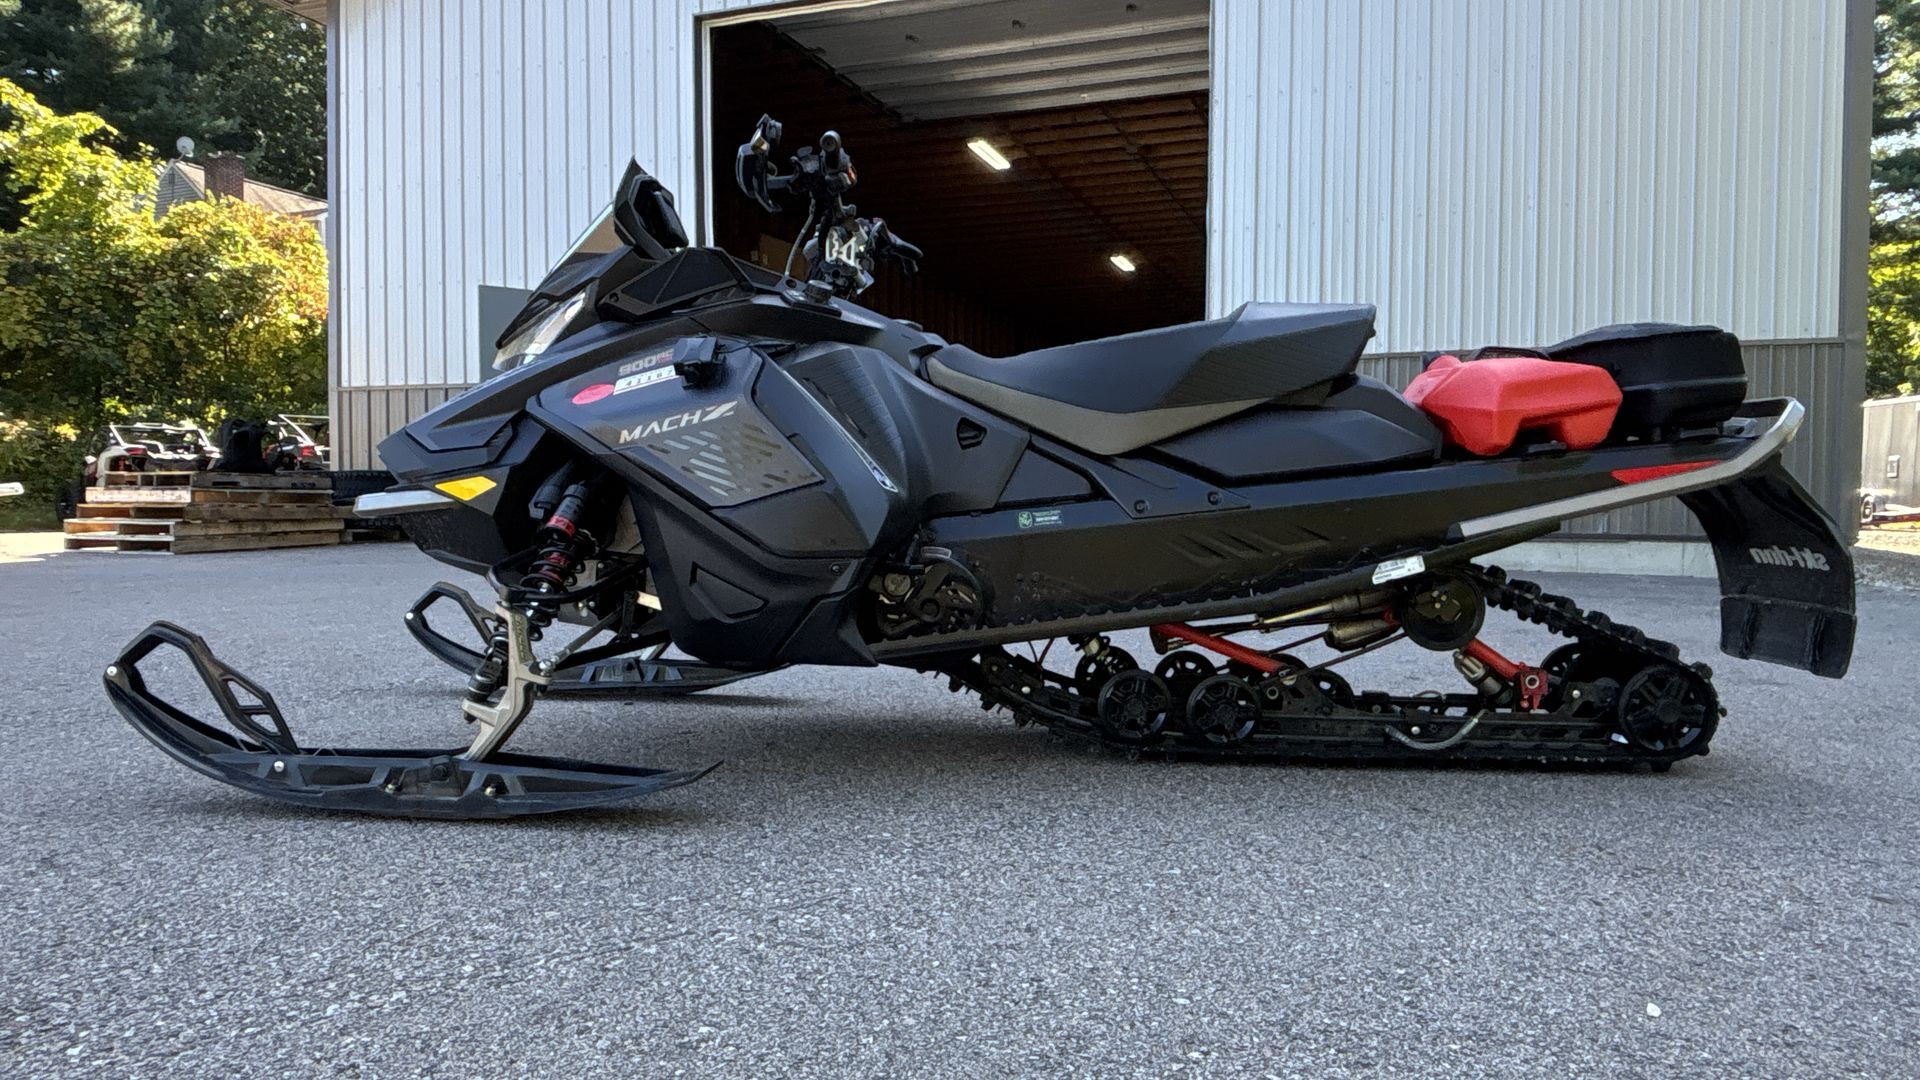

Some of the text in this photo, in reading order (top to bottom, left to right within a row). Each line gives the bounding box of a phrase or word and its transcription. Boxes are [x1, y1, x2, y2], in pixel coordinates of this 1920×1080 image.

[618, 355, 657, 376] 900
[618, 400, 738, 444] MACH Z
